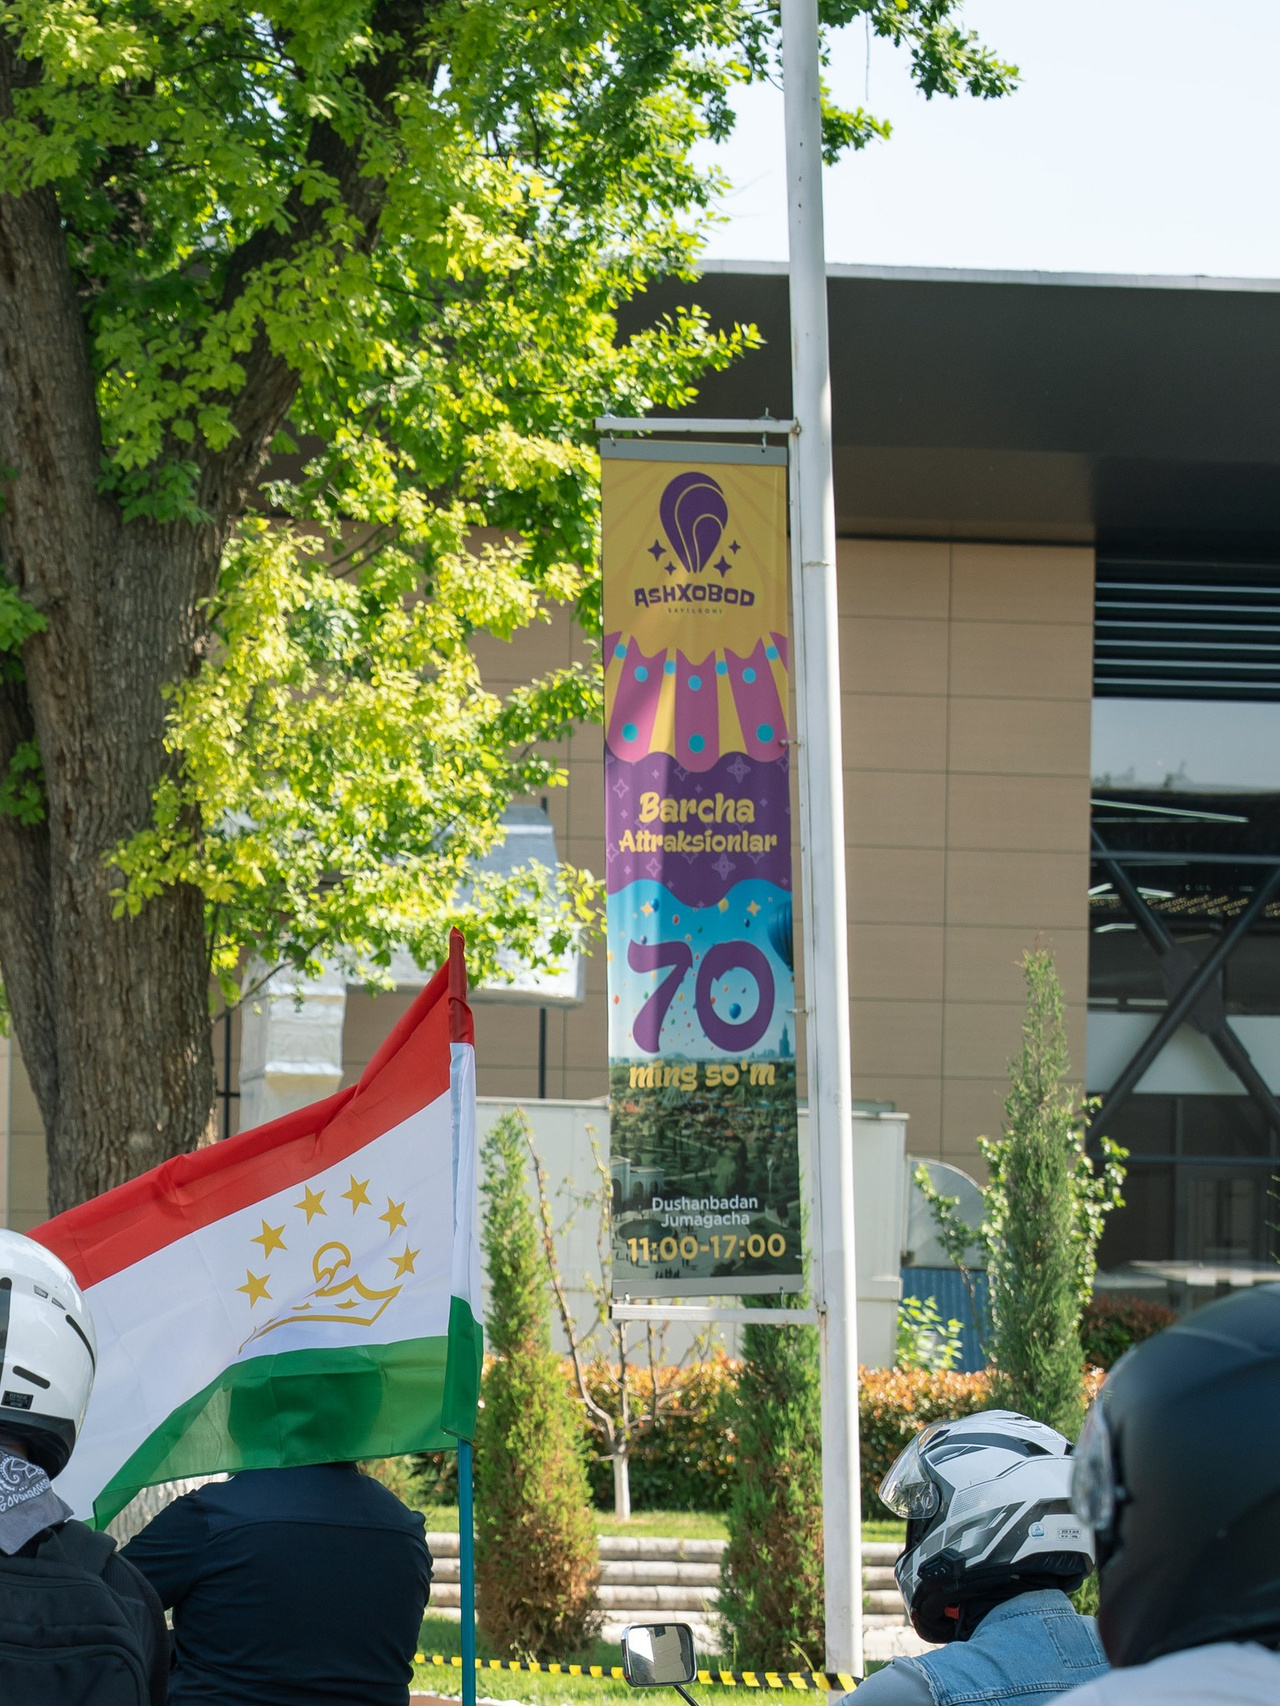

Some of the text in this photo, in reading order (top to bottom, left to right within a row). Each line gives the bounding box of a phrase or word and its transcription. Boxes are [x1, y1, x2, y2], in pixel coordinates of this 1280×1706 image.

[639, 792, 755, 824] Barcha
[619, 829, 778, 853] Attraksionlar
[627, 939, 775, 1054] 70
[629, 1062, 697, 1092] ming
[652, 1195, 758, 1213] Dushanbadan
[661, 1212, 751, 1231] Jumagacha
[627, 1233, 786, 1261] 11:00-17:00
